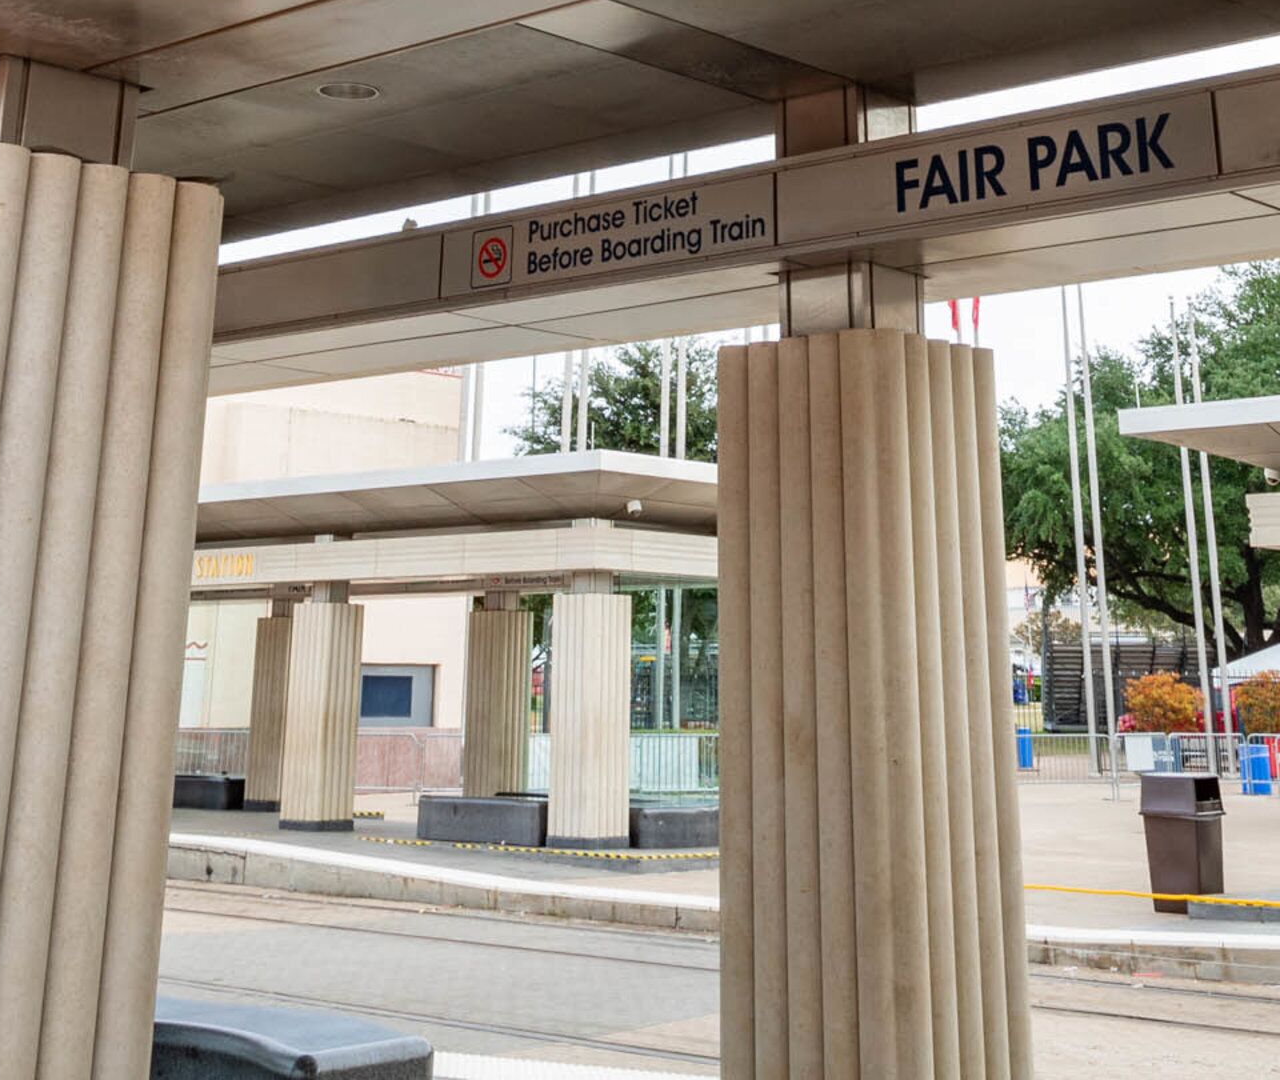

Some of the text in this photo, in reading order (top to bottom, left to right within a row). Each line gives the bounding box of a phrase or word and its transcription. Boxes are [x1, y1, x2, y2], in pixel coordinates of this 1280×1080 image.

[895, 113, 1175, 212] FAIR PARK
[527, 214, 765, 274] Before Boarding Train
[528, 191, 698, 243] Purchase Ticket
